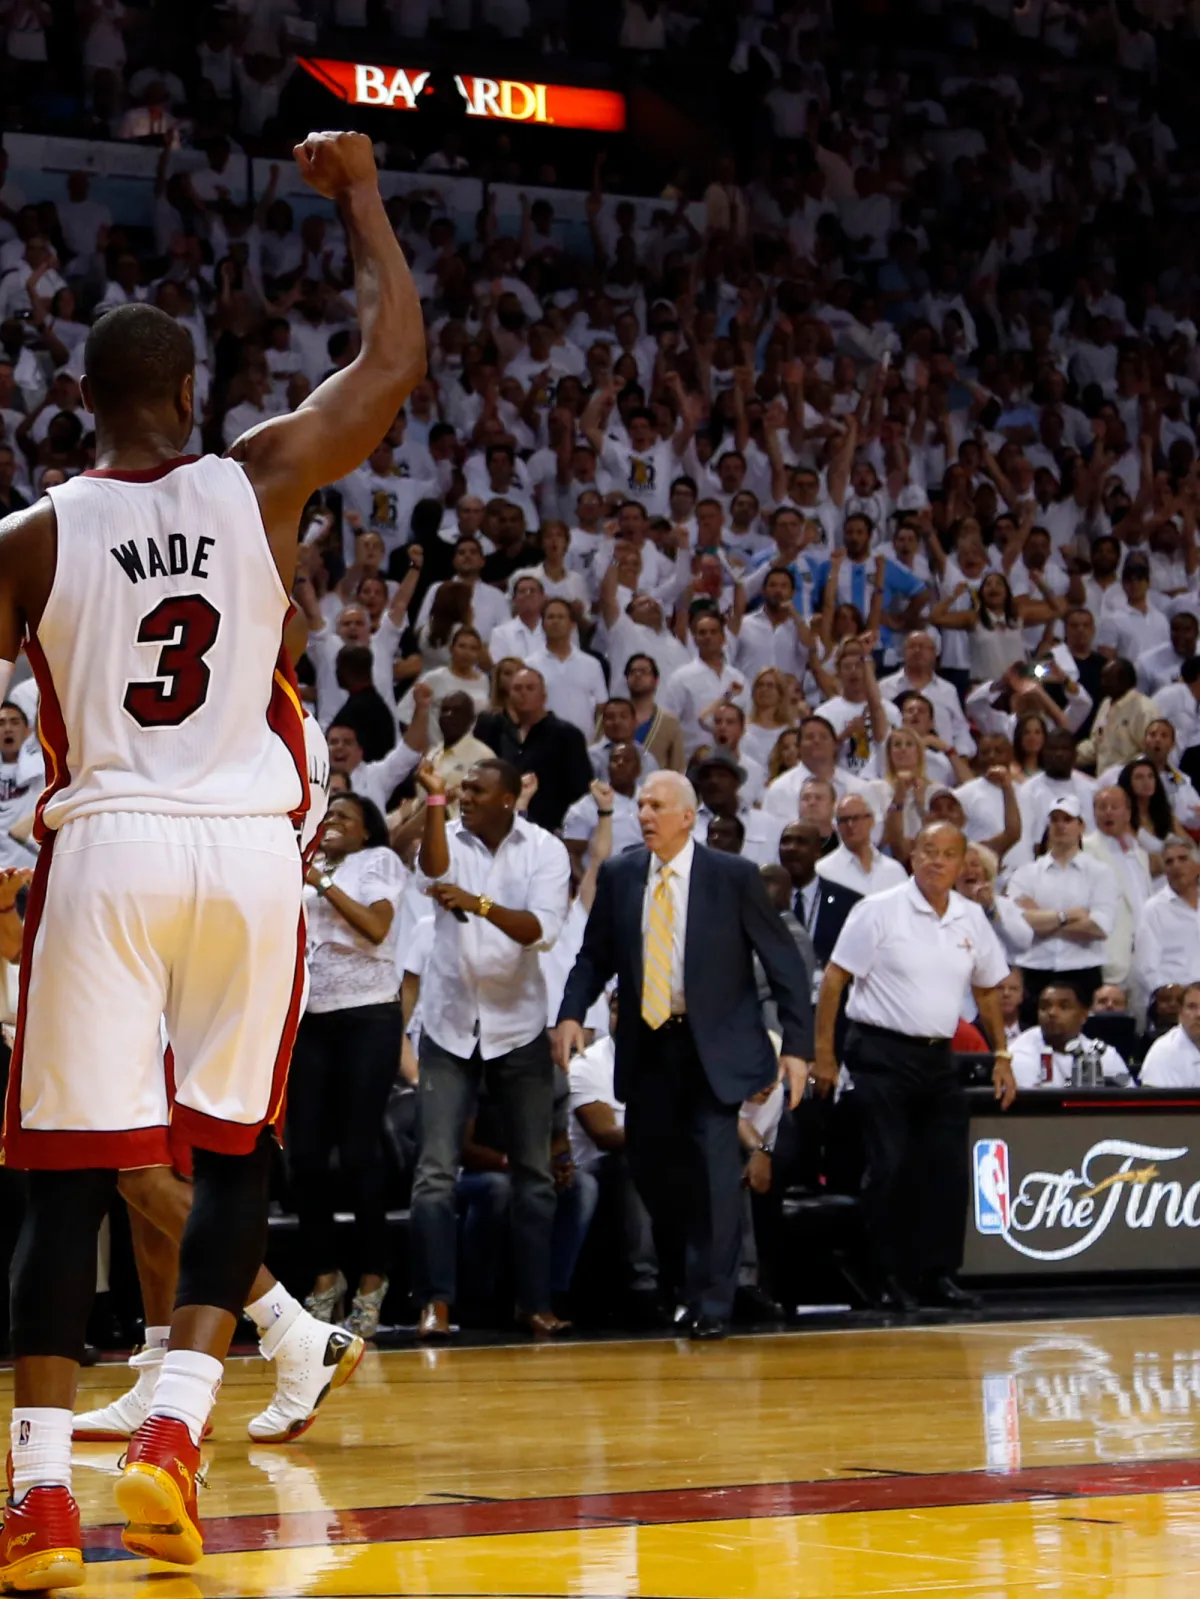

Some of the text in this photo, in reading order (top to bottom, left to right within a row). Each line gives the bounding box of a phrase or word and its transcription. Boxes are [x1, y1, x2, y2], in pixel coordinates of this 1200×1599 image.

[110, 533, 216, 585] WADE
[121, 591, 222, 730] 3
[1011, 1169, 1096, 1231] The
